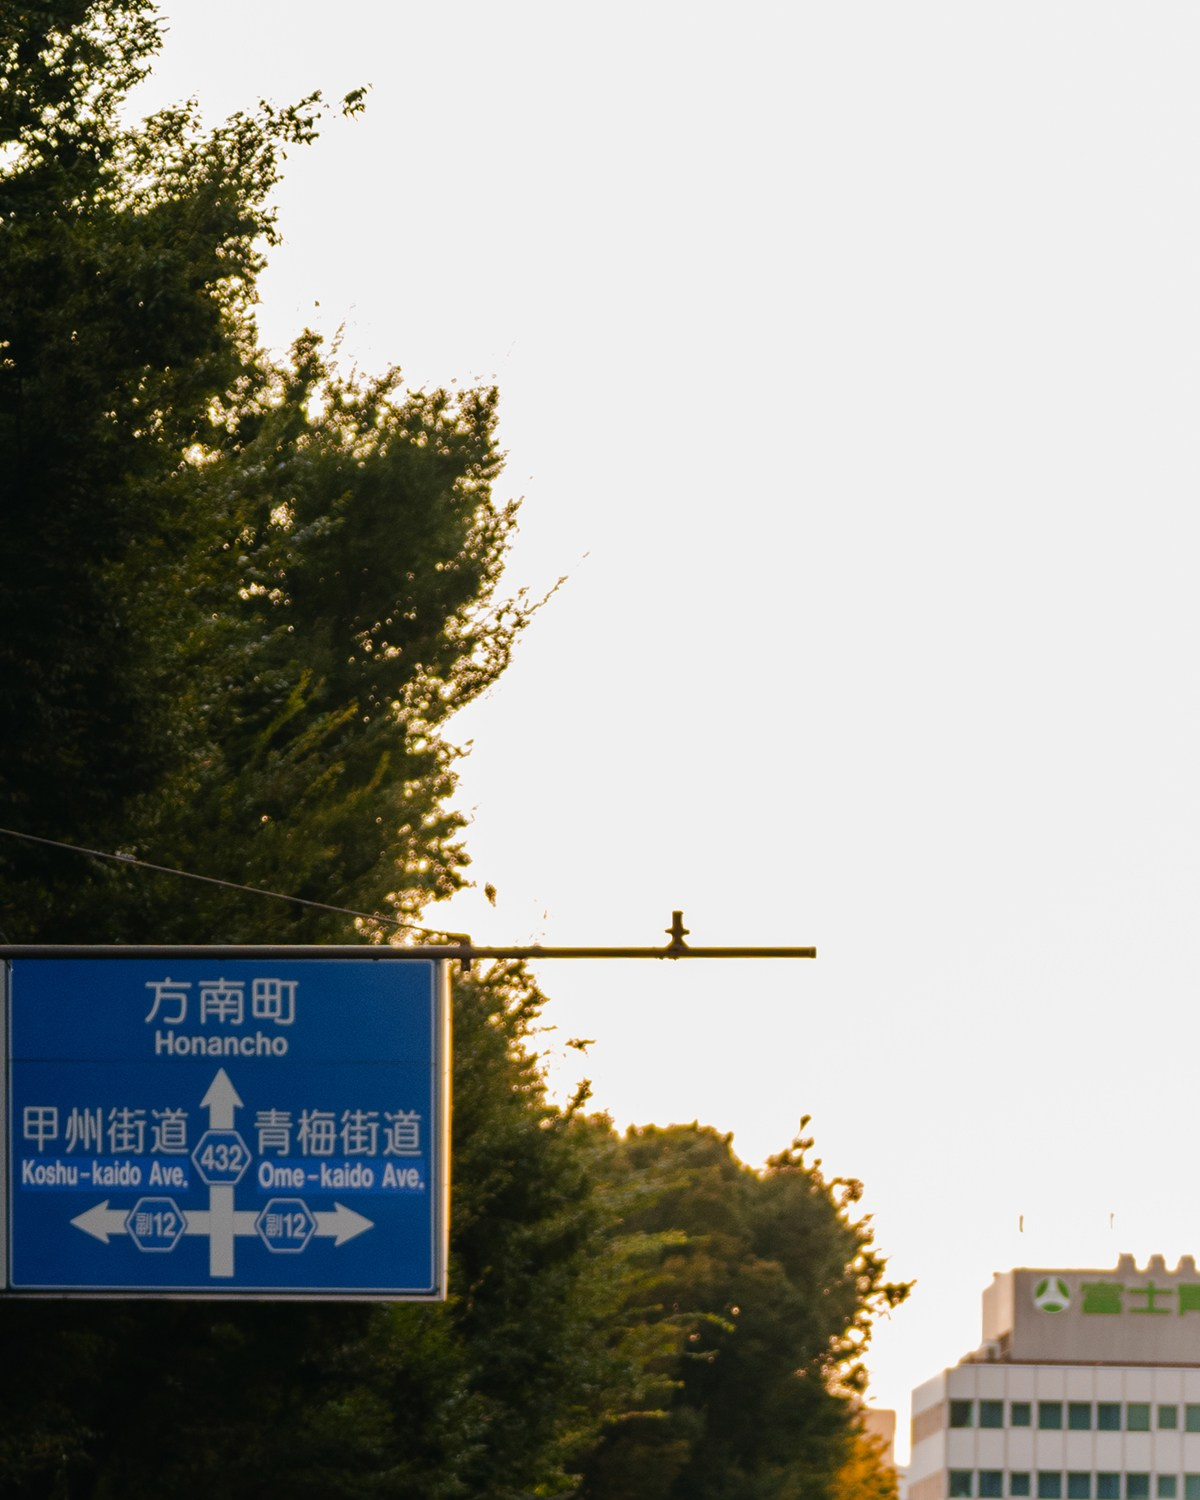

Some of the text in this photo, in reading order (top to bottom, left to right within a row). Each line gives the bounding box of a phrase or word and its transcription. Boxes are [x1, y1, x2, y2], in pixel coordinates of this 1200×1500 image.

[145, 977, 299, 1025] 方南町
[155, 1030, 289, 1056] Honancho
[22, 1106, 189, 1155] 甲州街道
[254, 1108, 423, 1157] 青梅街道
[201, 1144, 243, 1171] 432
[22, 1160, 189, 1188] Koshu-kaido Ave.
[258, 1161, 425, 1189] Ome-kaido Ave.
